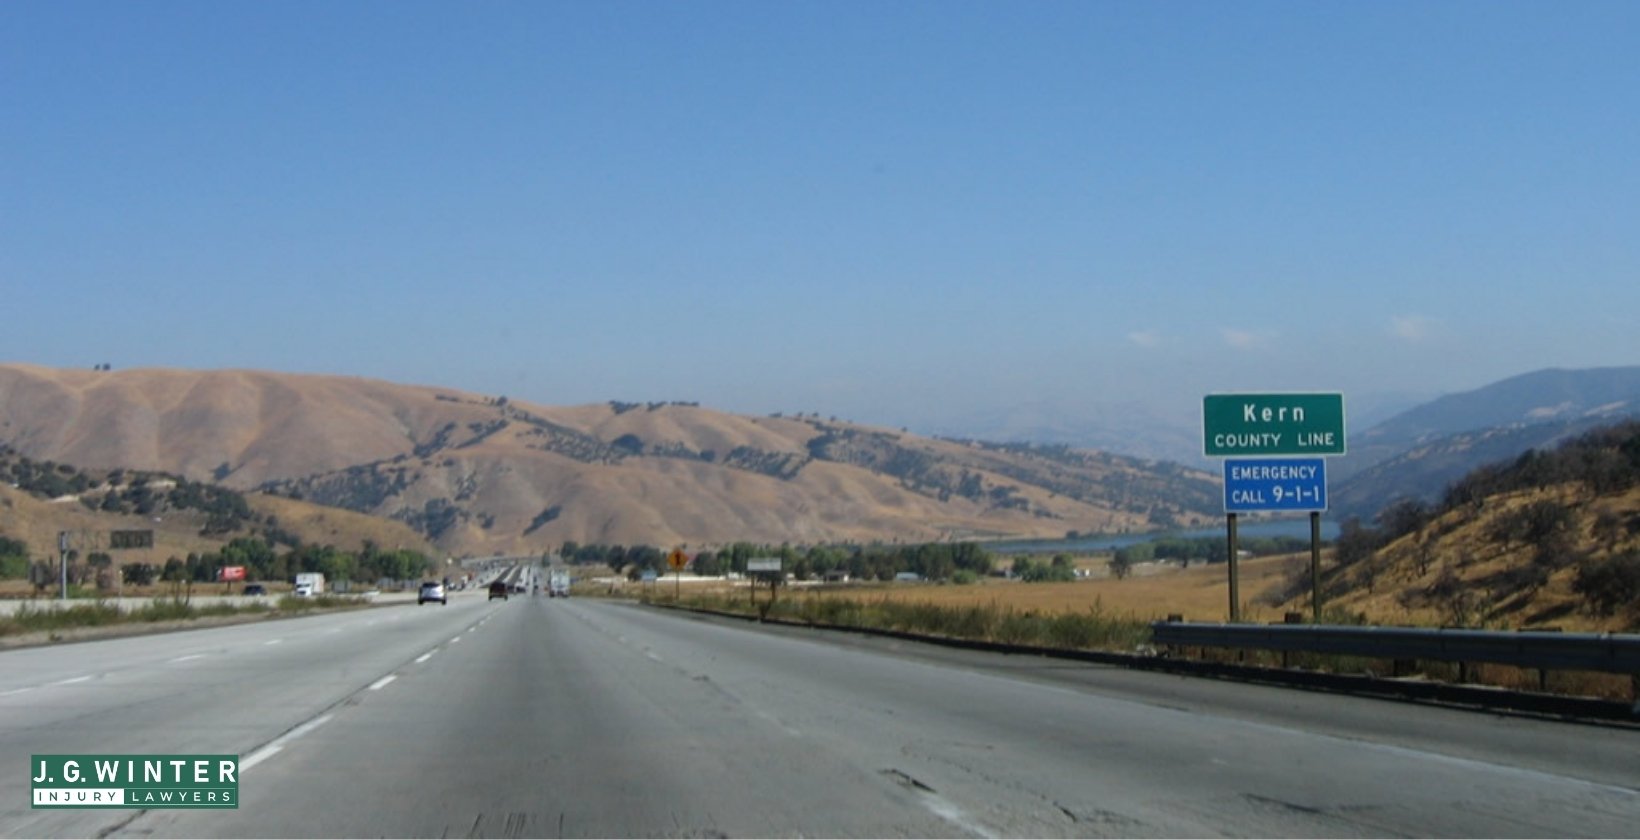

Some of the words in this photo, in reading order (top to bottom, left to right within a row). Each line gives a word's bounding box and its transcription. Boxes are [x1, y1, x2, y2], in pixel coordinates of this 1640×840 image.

[1243, 404, 1304, 422] Kern
[1215, 433, 1281, 447] COUNTY
[1298, 432, 1334, 446] LINE
[1232, 466, 1316, 480] EMERGENCY
[1232, 490, 1265, 504] CALL
[1272, 485, 1319, 502] 9-1-1
